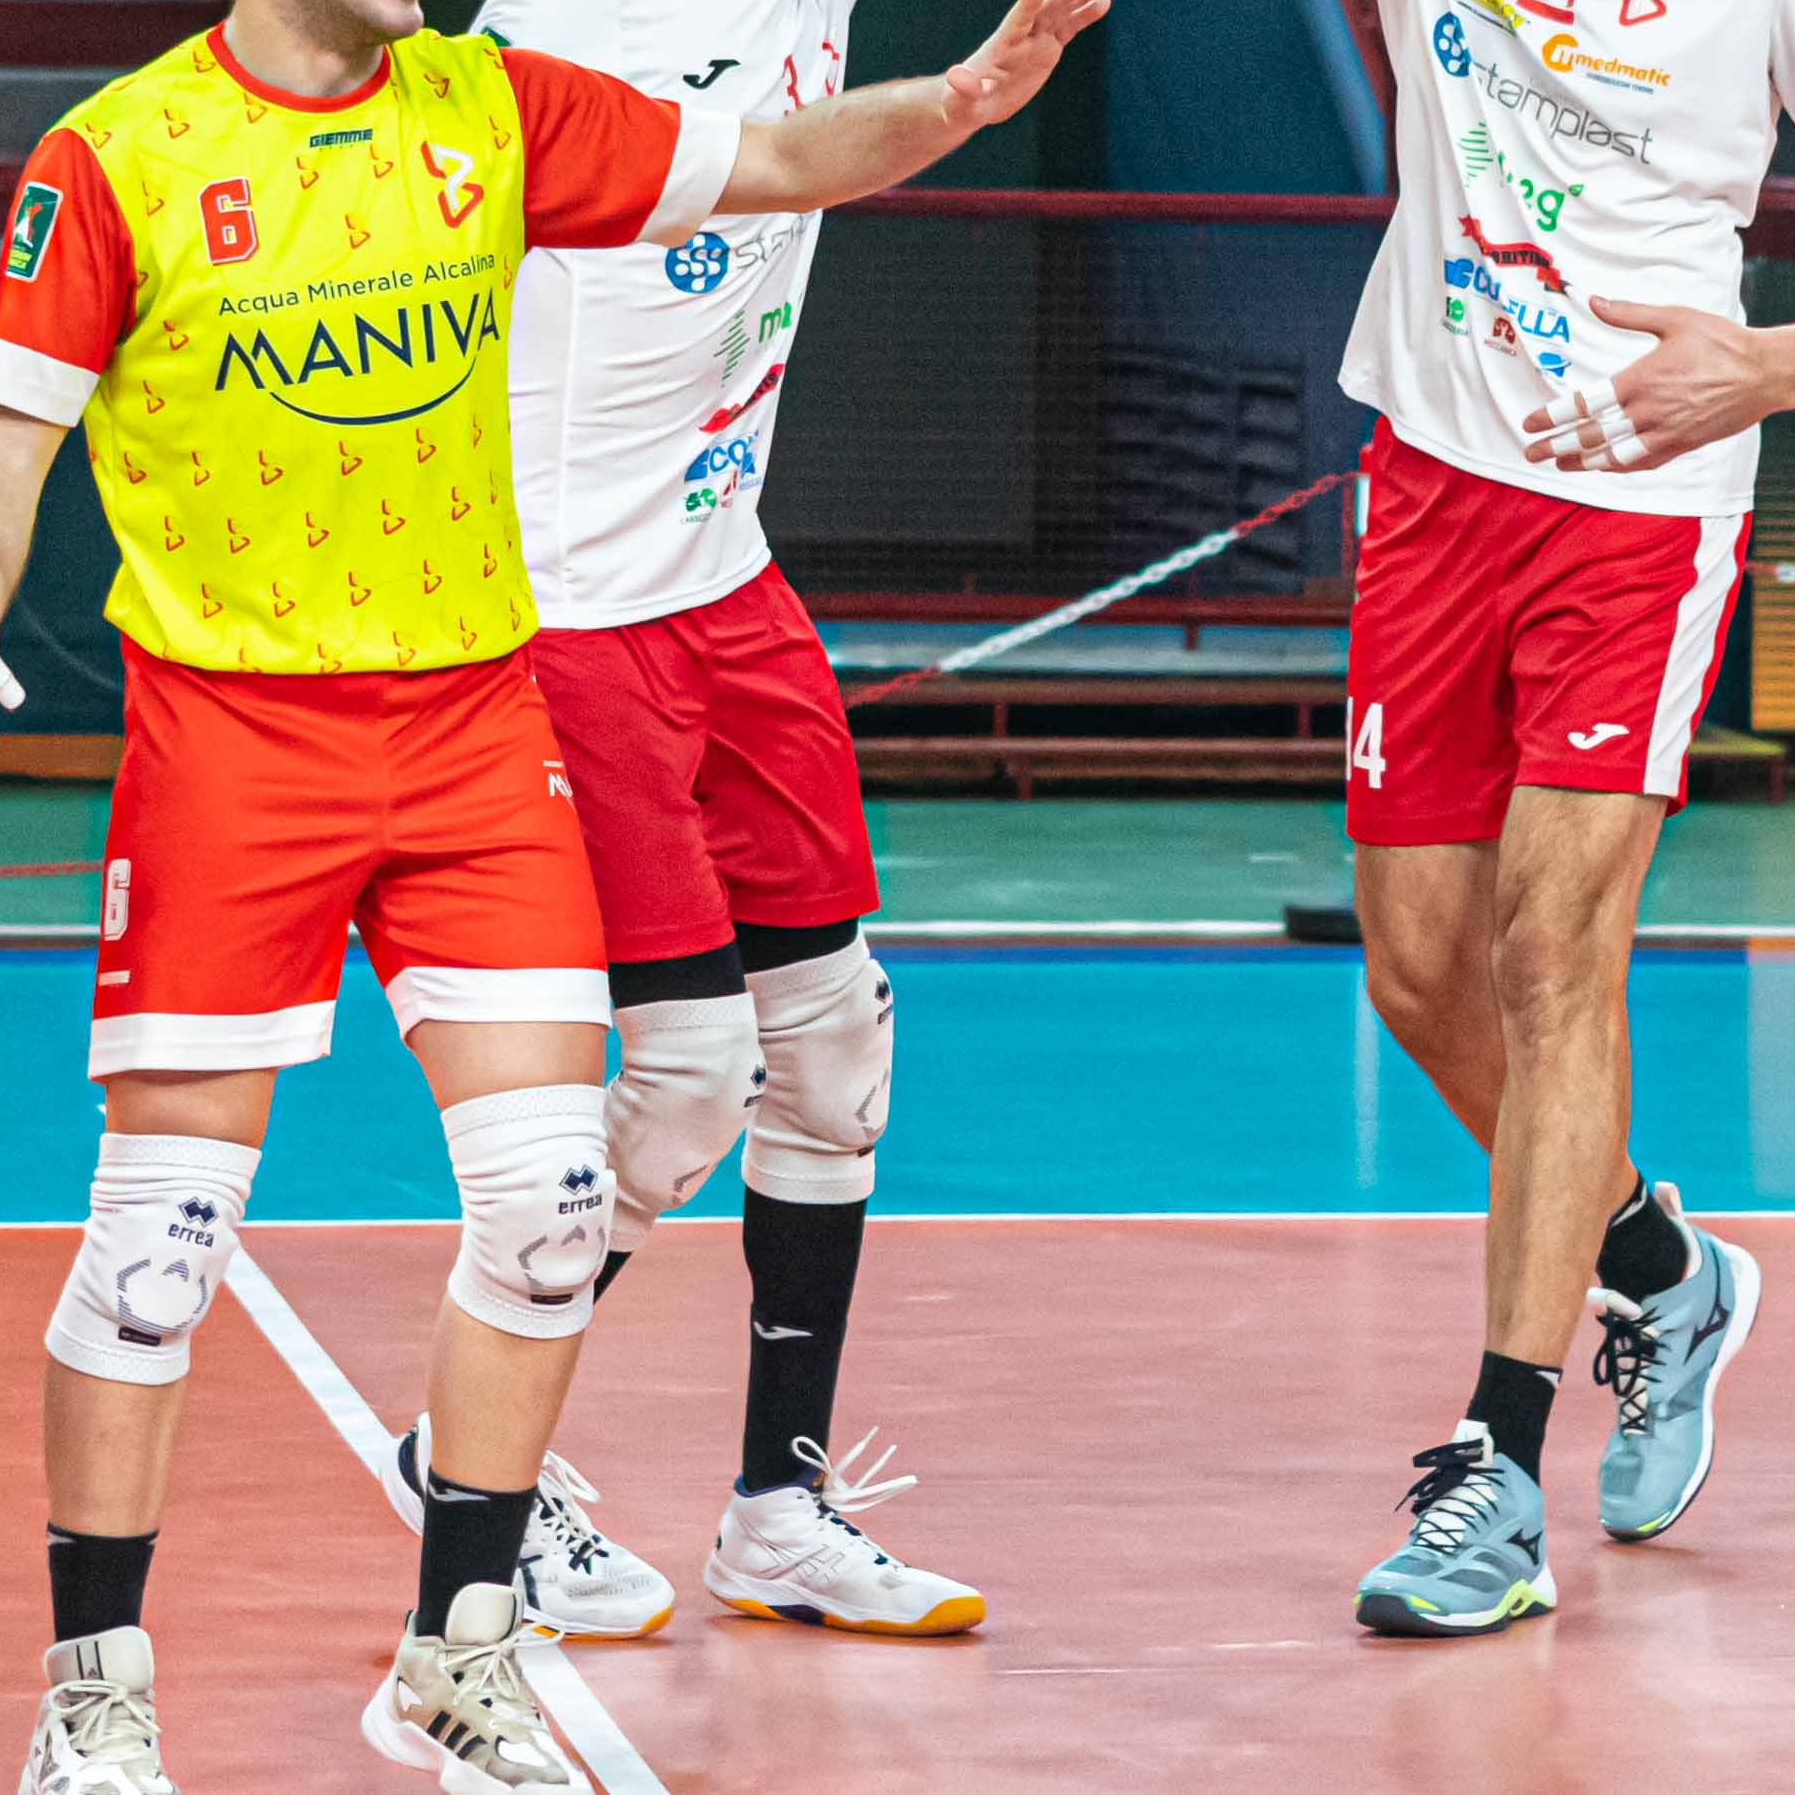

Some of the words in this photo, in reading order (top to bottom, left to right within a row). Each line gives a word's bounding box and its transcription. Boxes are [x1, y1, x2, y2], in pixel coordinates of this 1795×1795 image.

[199, 176, 260, 265] 6
[218, 287, 300, 318] Acqua
[307, 270, 414, 302] Minerale
[423, 252, 496, 283] Alcalina
[214, 287, 500, 392] MANIVA
